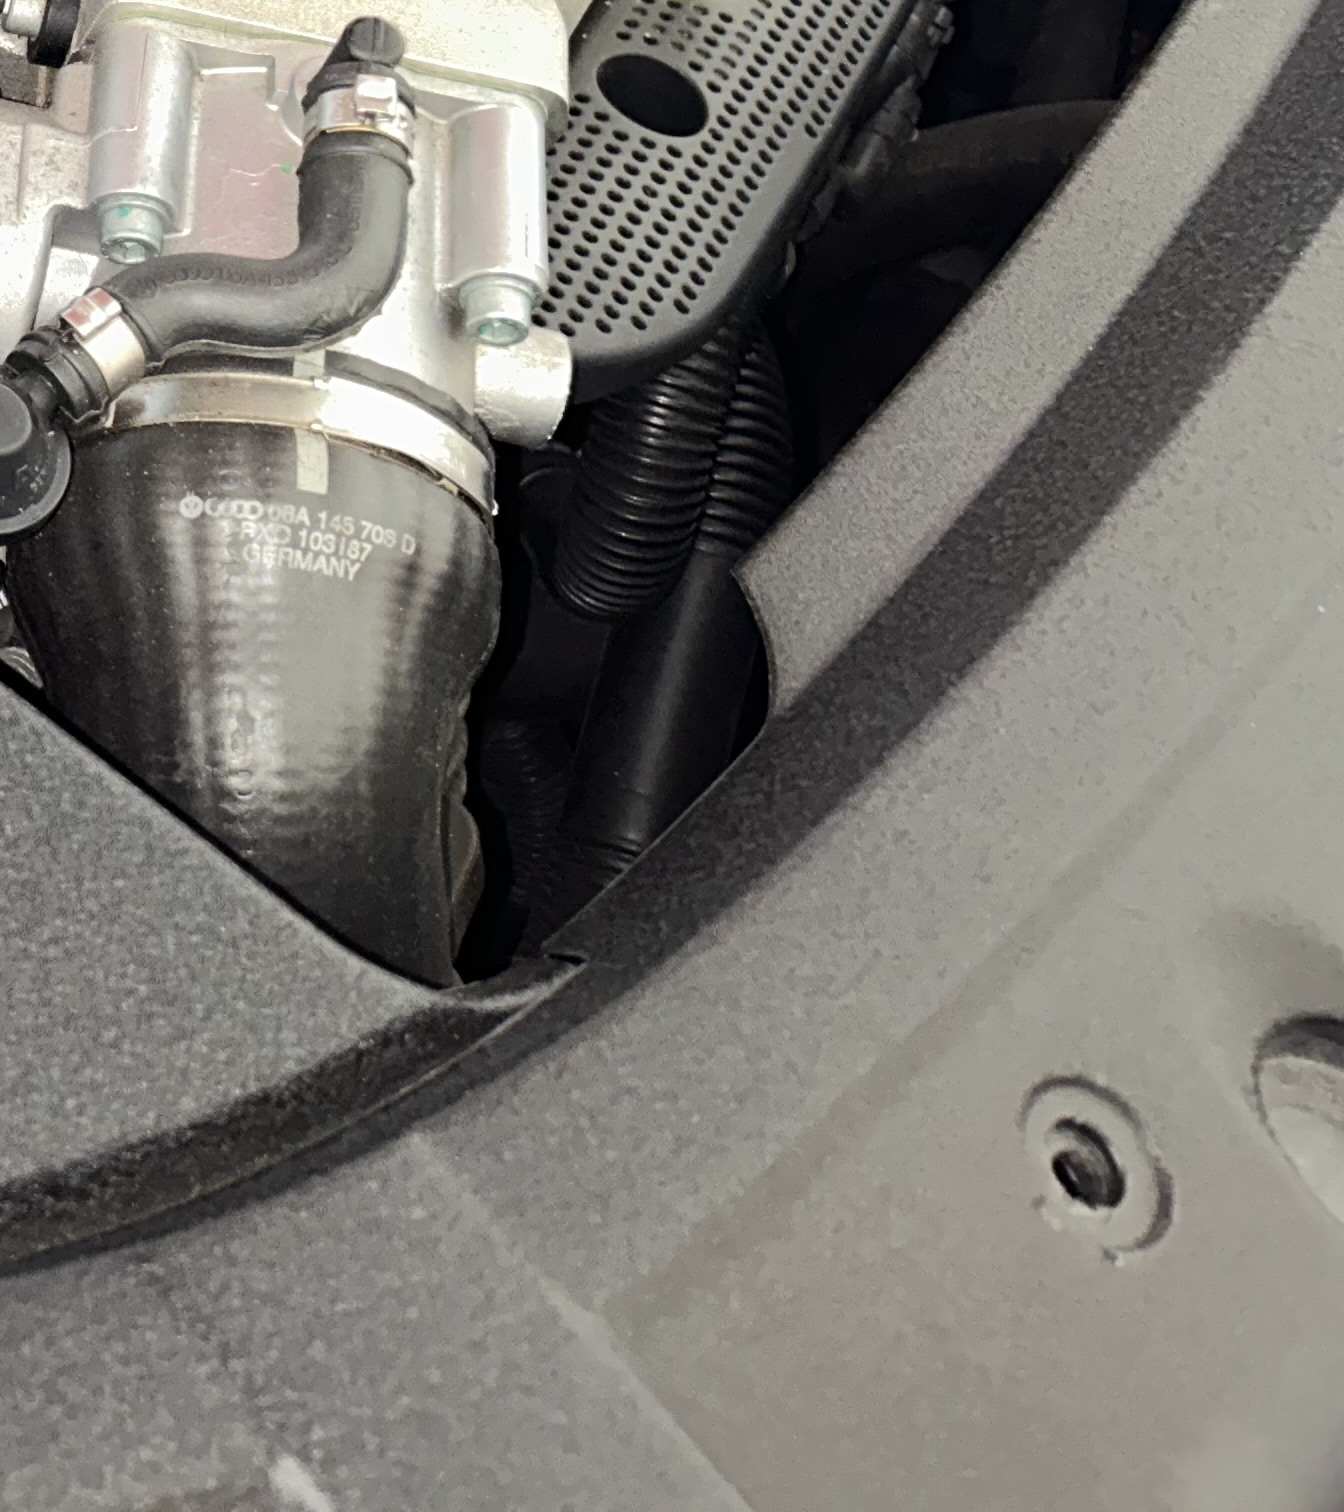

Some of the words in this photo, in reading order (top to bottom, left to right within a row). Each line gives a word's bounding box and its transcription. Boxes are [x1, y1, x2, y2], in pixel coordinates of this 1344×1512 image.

[318, 510, 355, 536] 145
[400, 533, 417, 556] D
[242, 543, 362, 582] GERMANY
